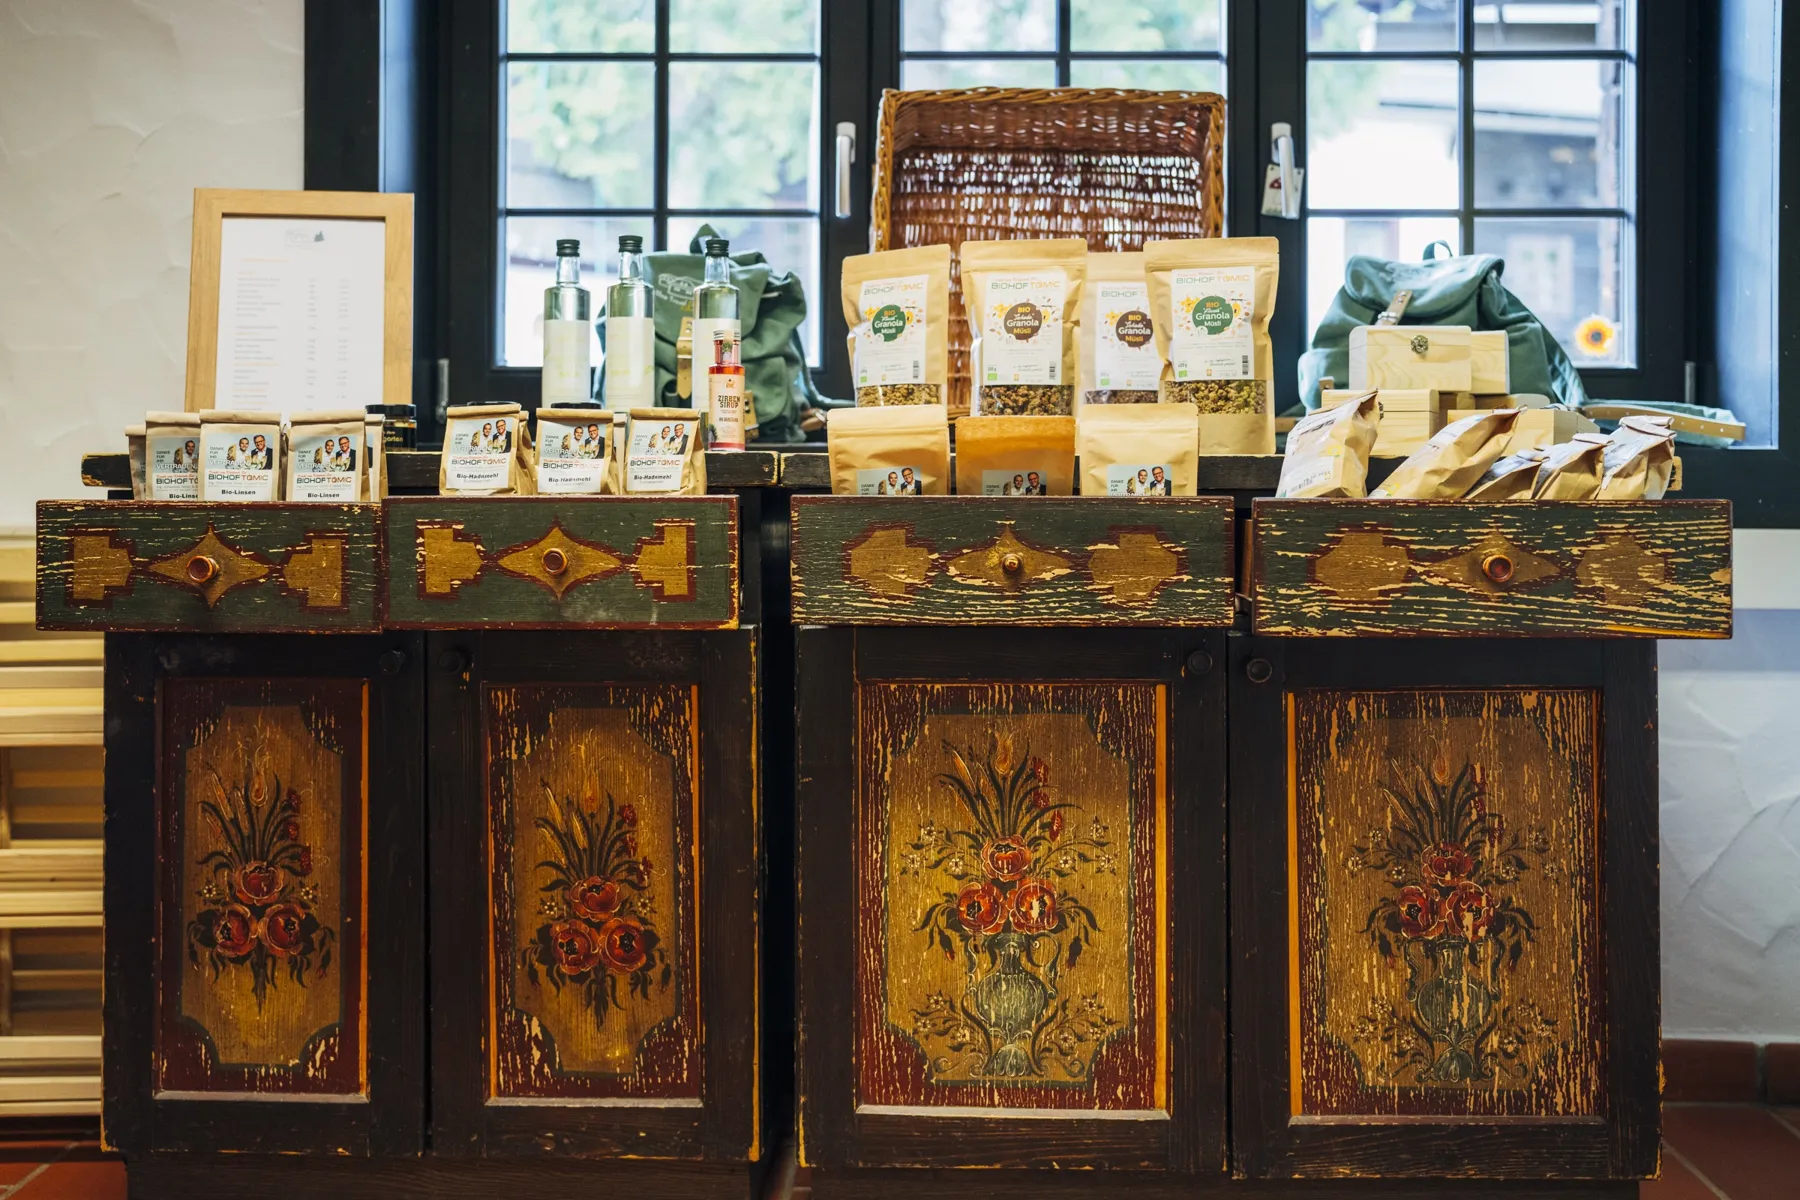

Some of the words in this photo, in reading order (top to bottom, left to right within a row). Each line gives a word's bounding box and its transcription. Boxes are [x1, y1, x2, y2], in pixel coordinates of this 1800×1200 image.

[1176, 276, 1215, 284] BIOHOF
[991, 282, 1029, 290] BIOHOF
[864, 286, 895, 296] BIOHOF
[1195, 312, 1230, 320] Granola
[874, 320, 904, 328] Granola
[1006, 318, 1040, 327] Granola
[1118, 327, 1151, 335] Granola
